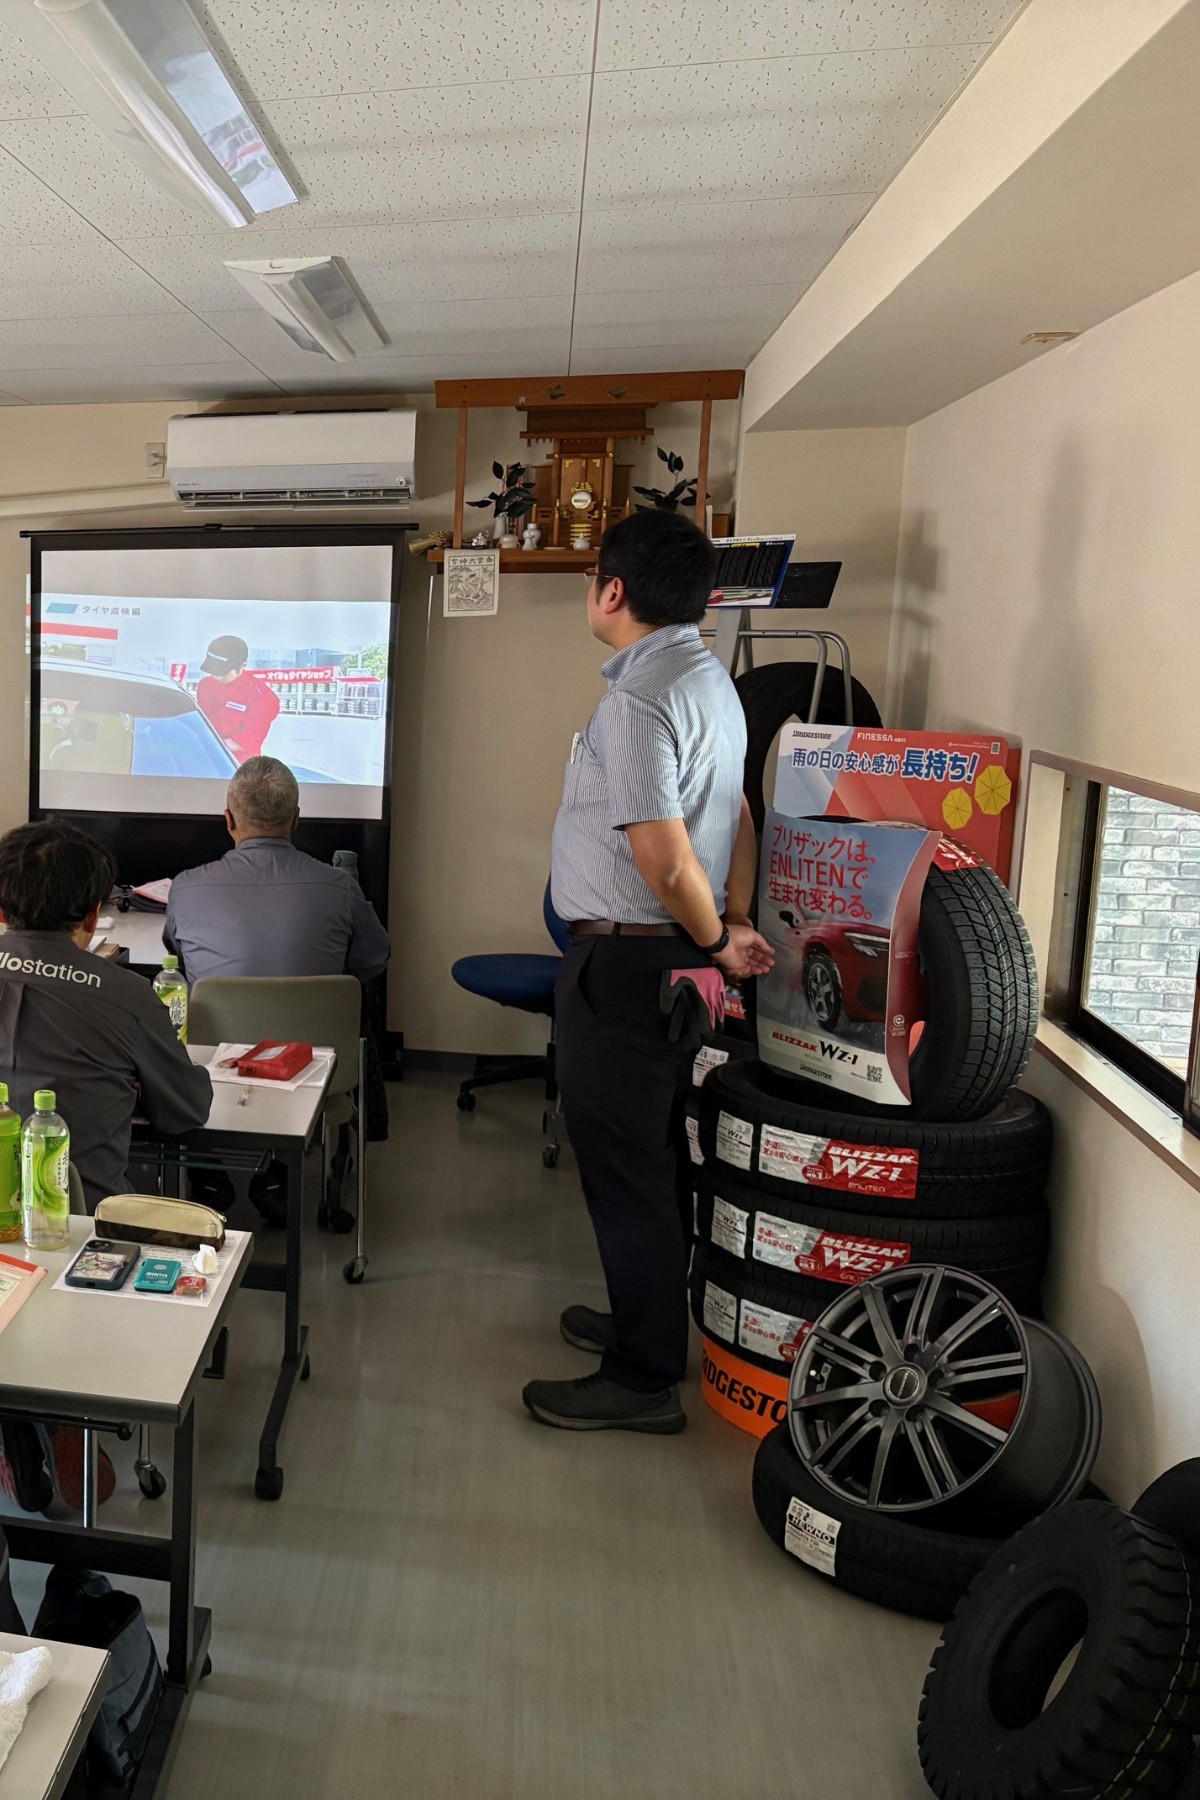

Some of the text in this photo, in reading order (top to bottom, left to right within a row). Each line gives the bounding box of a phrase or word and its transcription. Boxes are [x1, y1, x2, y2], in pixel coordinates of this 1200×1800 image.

[792, 729, 832, 740] BRIDGESTONE
[856, 732, 894, 742] FINESSA
[773, 824, 877, 864] ブリザックは、
[768, 877, 873, 920] 生まれ変わる。
[771, 1031, 818, 1053] BLIZZAK
[819, 1040, 859, 1066] WZ-1
[827, 1146, 916, 1165] BLIZZAK
[829, 1154, 904, 1182] WZ-1
[847, 1182, 886, 1193] ENLITEN
[820, 1235, 907, 1259] BLIZZAK
[823, 1246, 894, 1273] WZ-1
